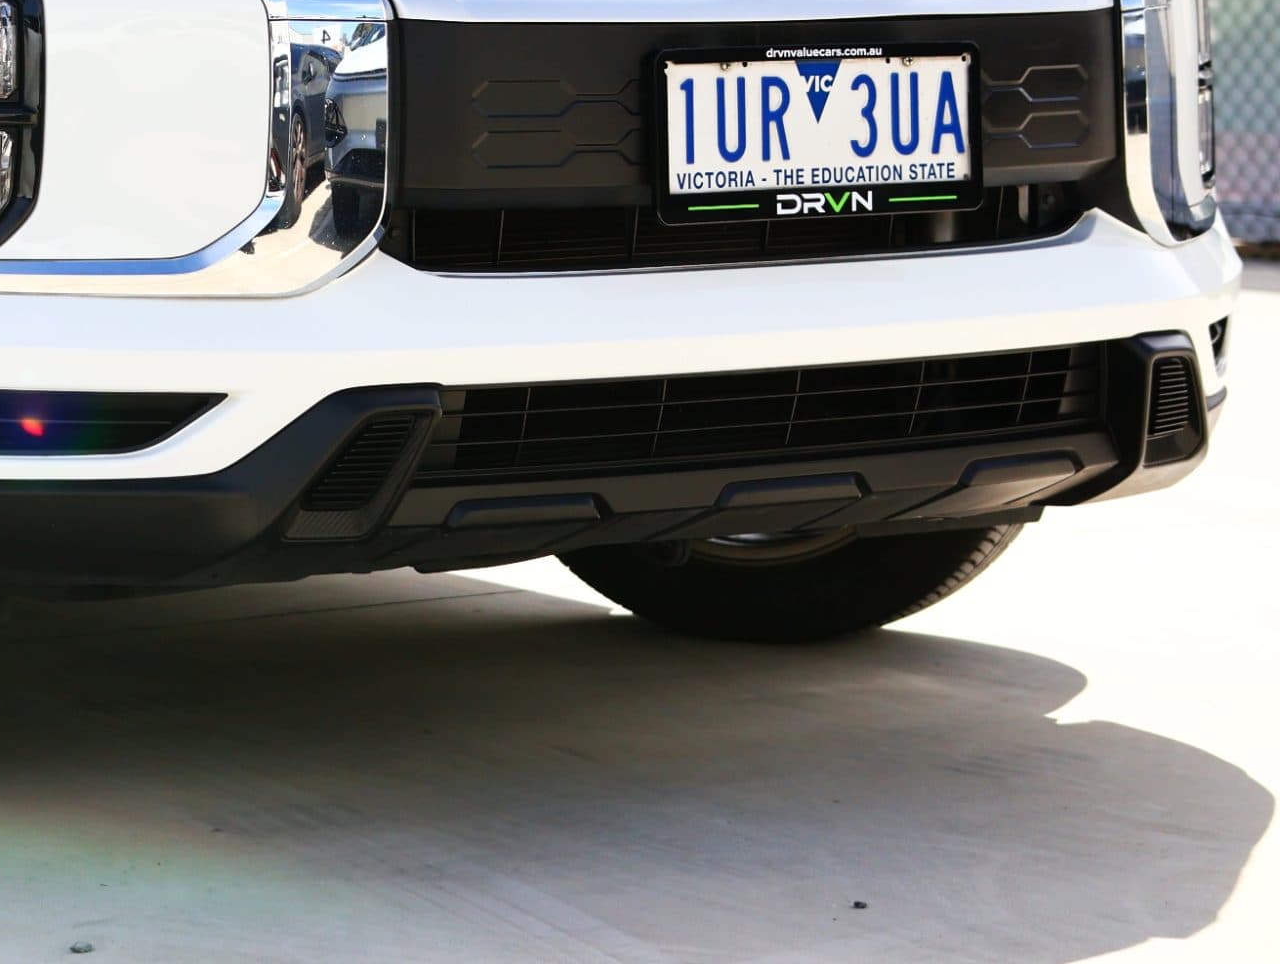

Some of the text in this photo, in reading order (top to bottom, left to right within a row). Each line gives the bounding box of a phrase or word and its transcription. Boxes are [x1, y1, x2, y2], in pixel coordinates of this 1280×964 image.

[766, 47, 882, 58] drvnvaluecars.com.au
[804, 75, 833, 93] VIC
[679, 71, 966, 164] 1UR 3UA
[677, 170, 755, 190] VICTORIA
[774, 168, 804, 185] THE
[812, 165, 902, 184] EDUCATION
[909, 162, 955, 180] STATE
[776, 190, 873, 215] DRVN
